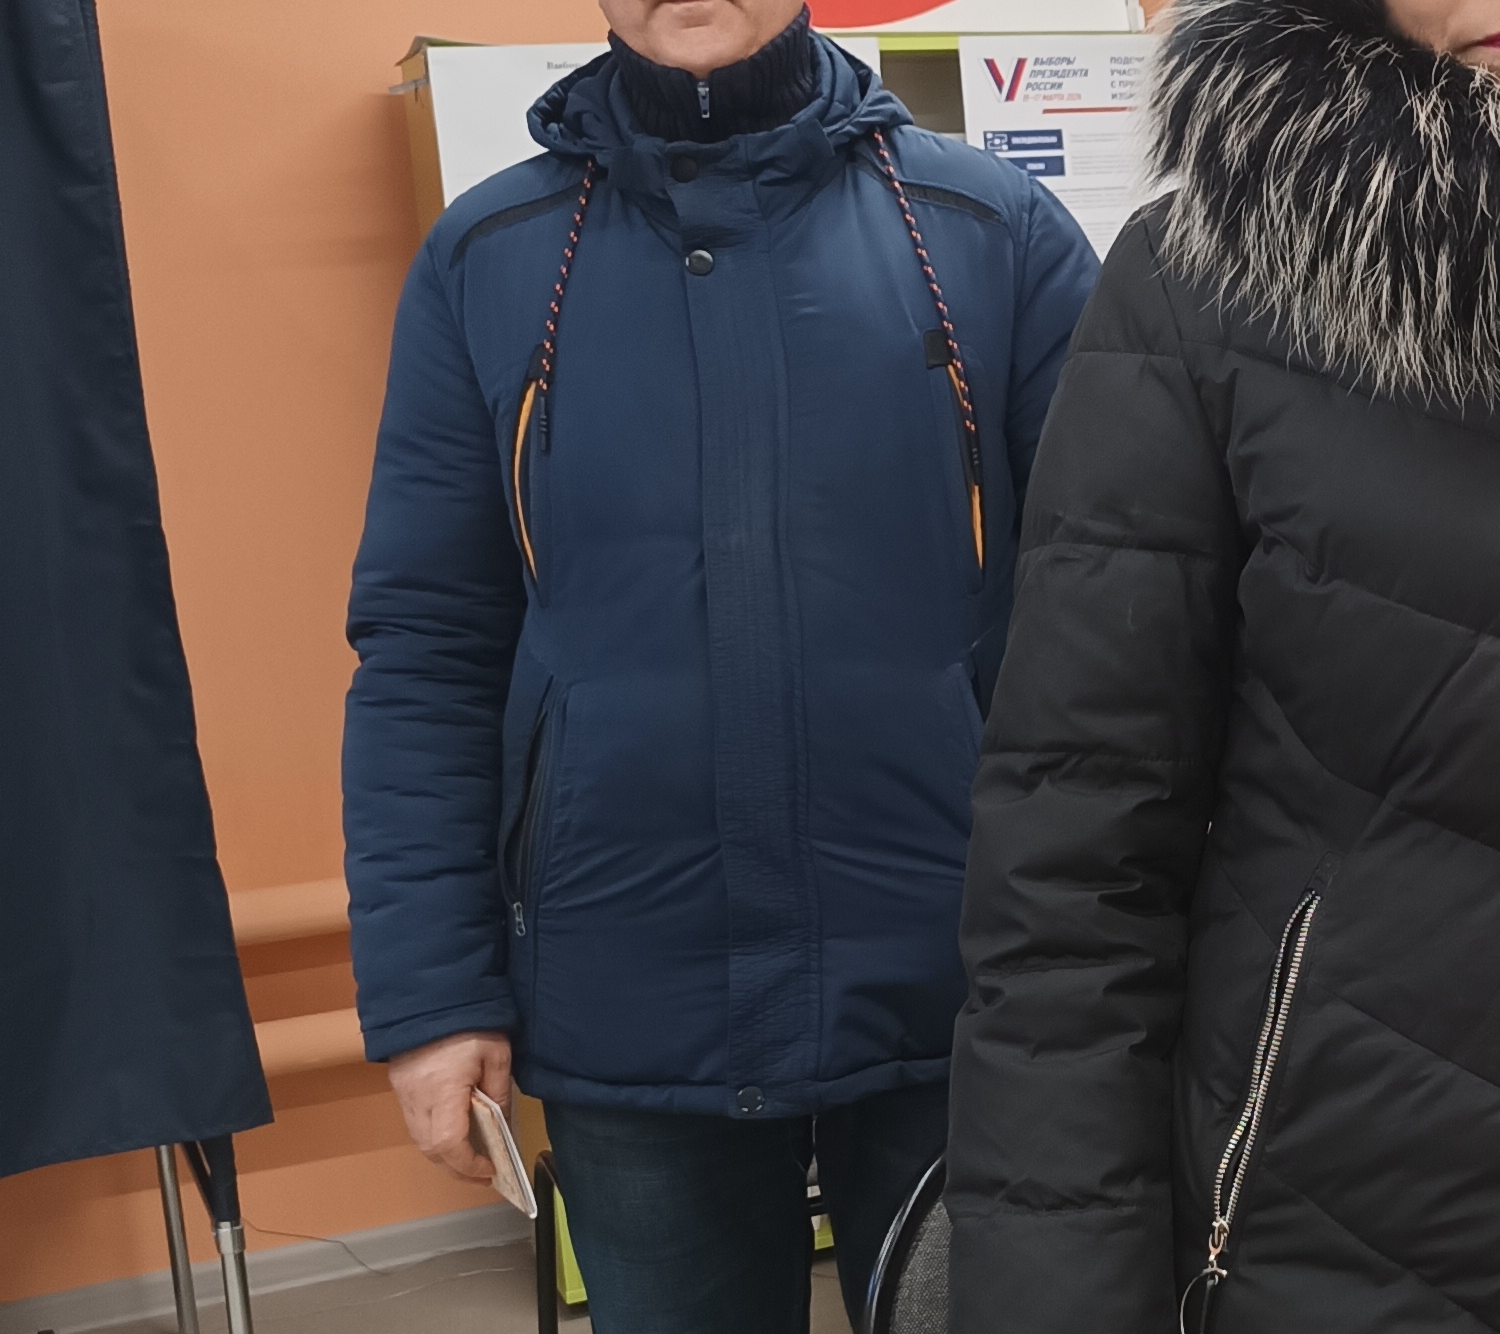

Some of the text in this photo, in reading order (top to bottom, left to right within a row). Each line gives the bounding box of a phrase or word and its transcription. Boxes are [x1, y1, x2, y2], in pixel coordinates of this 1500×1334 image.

[1033, 56, 1076, 66] ВЫБОРЫ
[1029, 68, 1088, 78] ПРЕЗИДЕНТА
[1025, 82, 1063, 91] РОССИИ
